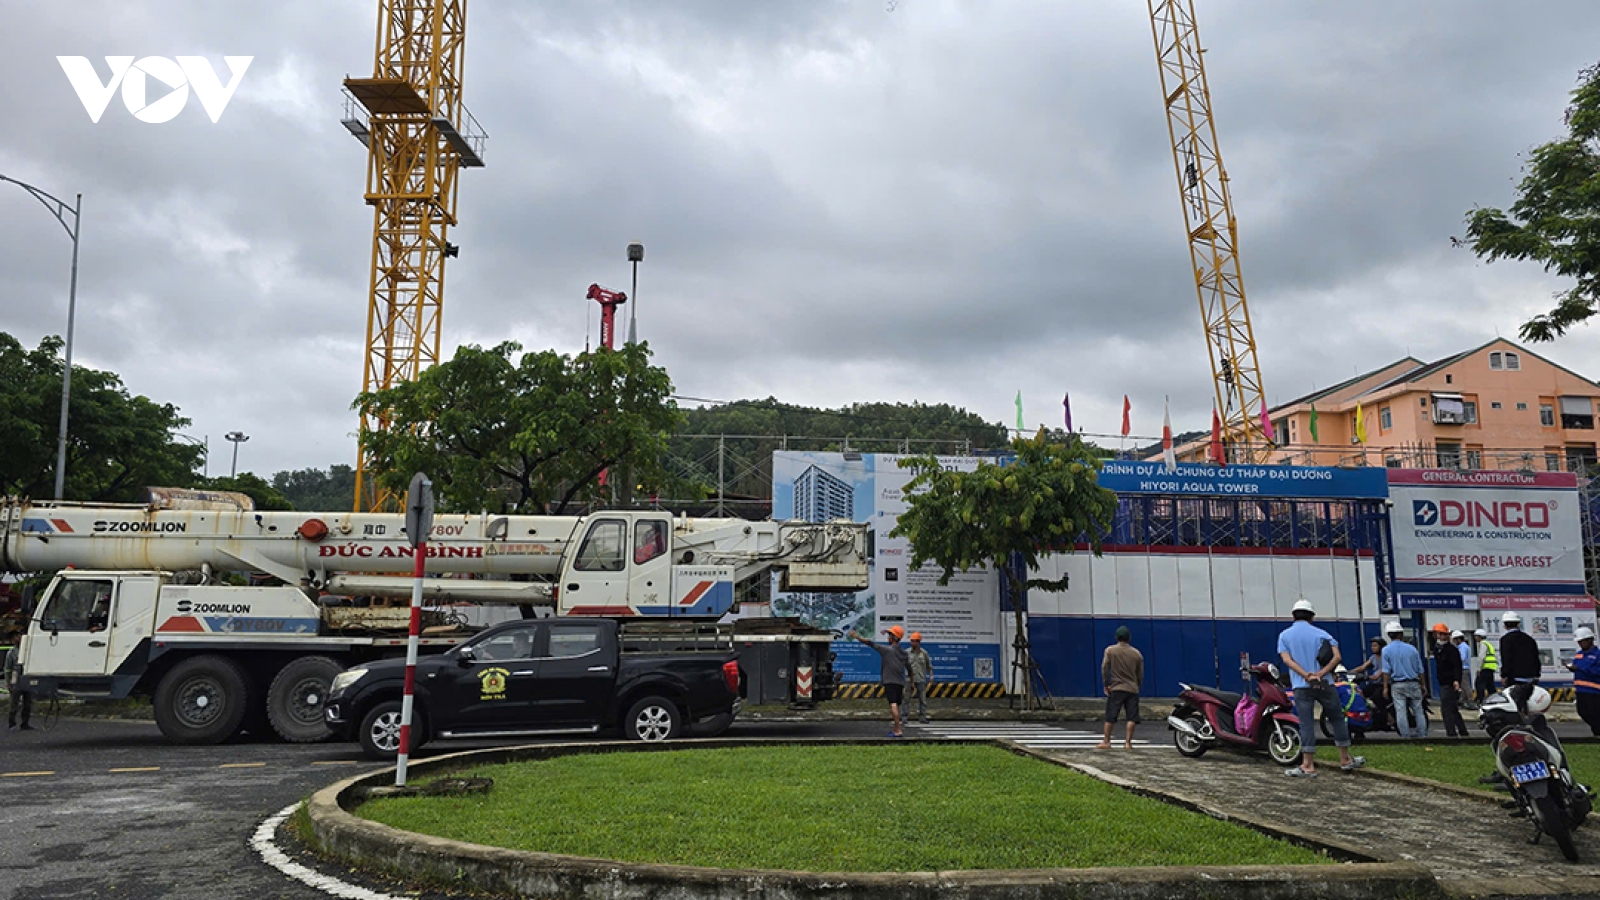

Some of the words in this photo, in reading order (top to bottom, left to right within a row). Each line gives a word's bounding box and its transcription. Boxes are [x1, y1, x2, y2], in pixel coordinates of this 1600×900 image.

[1137, 465, 1154, 478] DỰ
[1175, 467, 1215, 478] CHUNG
[1218, 468, 1234, 477] CƯ
[1237, 467, 1266, 480] THÁP
[1269, 469, 1290, 481] ĐẠI
[1291, 470, 1333, 480] DƯƠNG
[1422, 471, 1468, 482] GENERAL
[1140, 481, 1179, 491] HIYORI
[1182, 483, 1215, 493] AQUA
[1218, 483, 1259, 493] TOWER
[1439, 500, 1549, 528] DINCO
[108, 521, 187, 532] ZOOMLION
[1415, 529, 1474, 539] ENGINEERING
[1476, 530, 1482, 538] &
[1484, 530, 1551, 540] CONSTRUCTION
[318, 542, 373, 557] ĐỨC
[378, 546, 414, 558] AN
[424, 542, 484, 558] BÌNH
[1417, 554, 1446, 566] BEST
[1450, 555, 1495, 567] BEFORE
[1499, 556, 1553, 568] LARGEST
[193, 603, 251, 614] ZOOMLION
